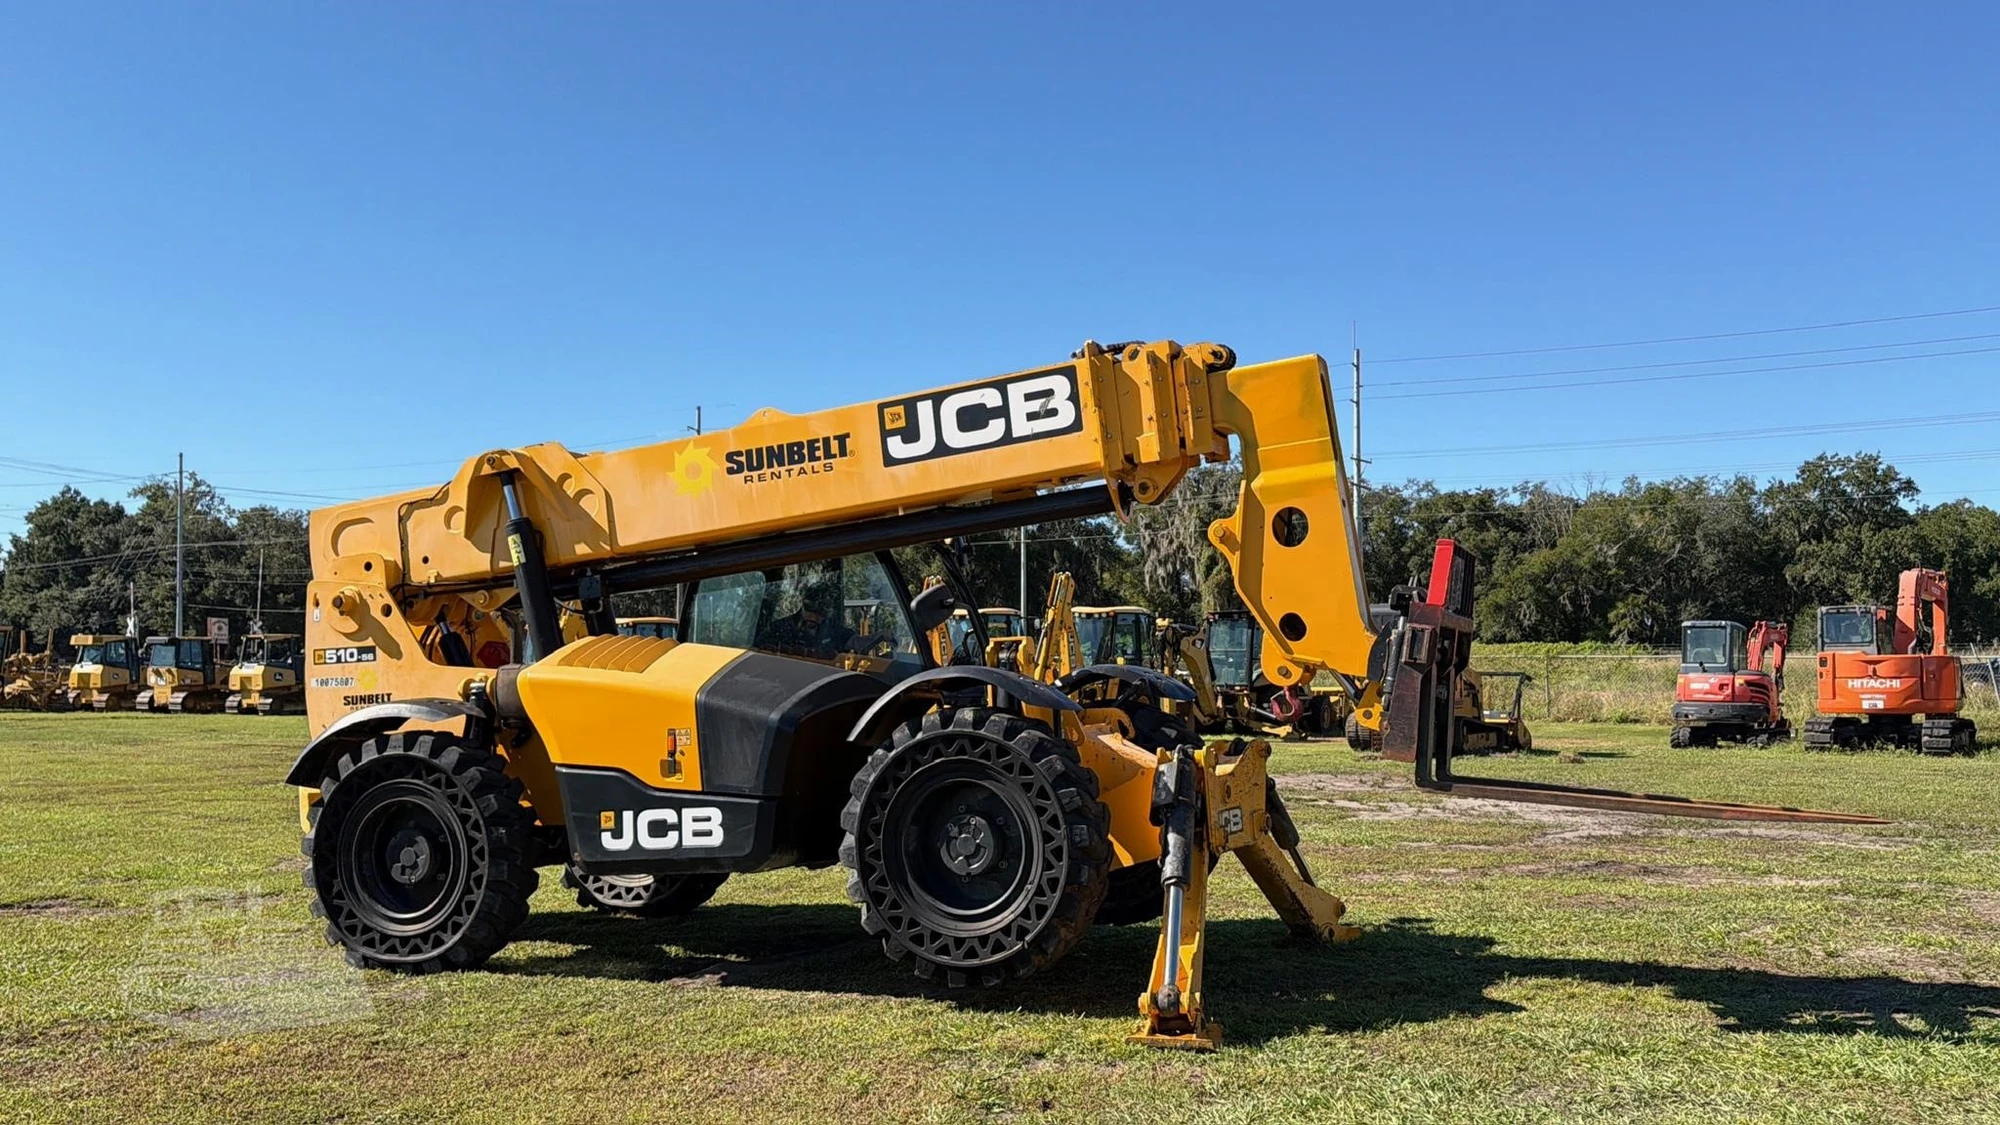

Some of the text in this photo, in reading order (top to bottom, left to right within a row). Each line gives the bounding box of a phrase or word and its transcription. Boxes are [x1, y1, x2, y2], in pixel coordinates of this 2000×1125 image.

[886, 374, 1076, 459] JCB
[725, 432, 851, 475] SUNBELT
[744, 462, 834, 485] RENTALS
[343, 692, 392, 706] SUNBELT
[1847, 679, 1900, 689] HITACHI
[601, 806, 724, 851] JCB
